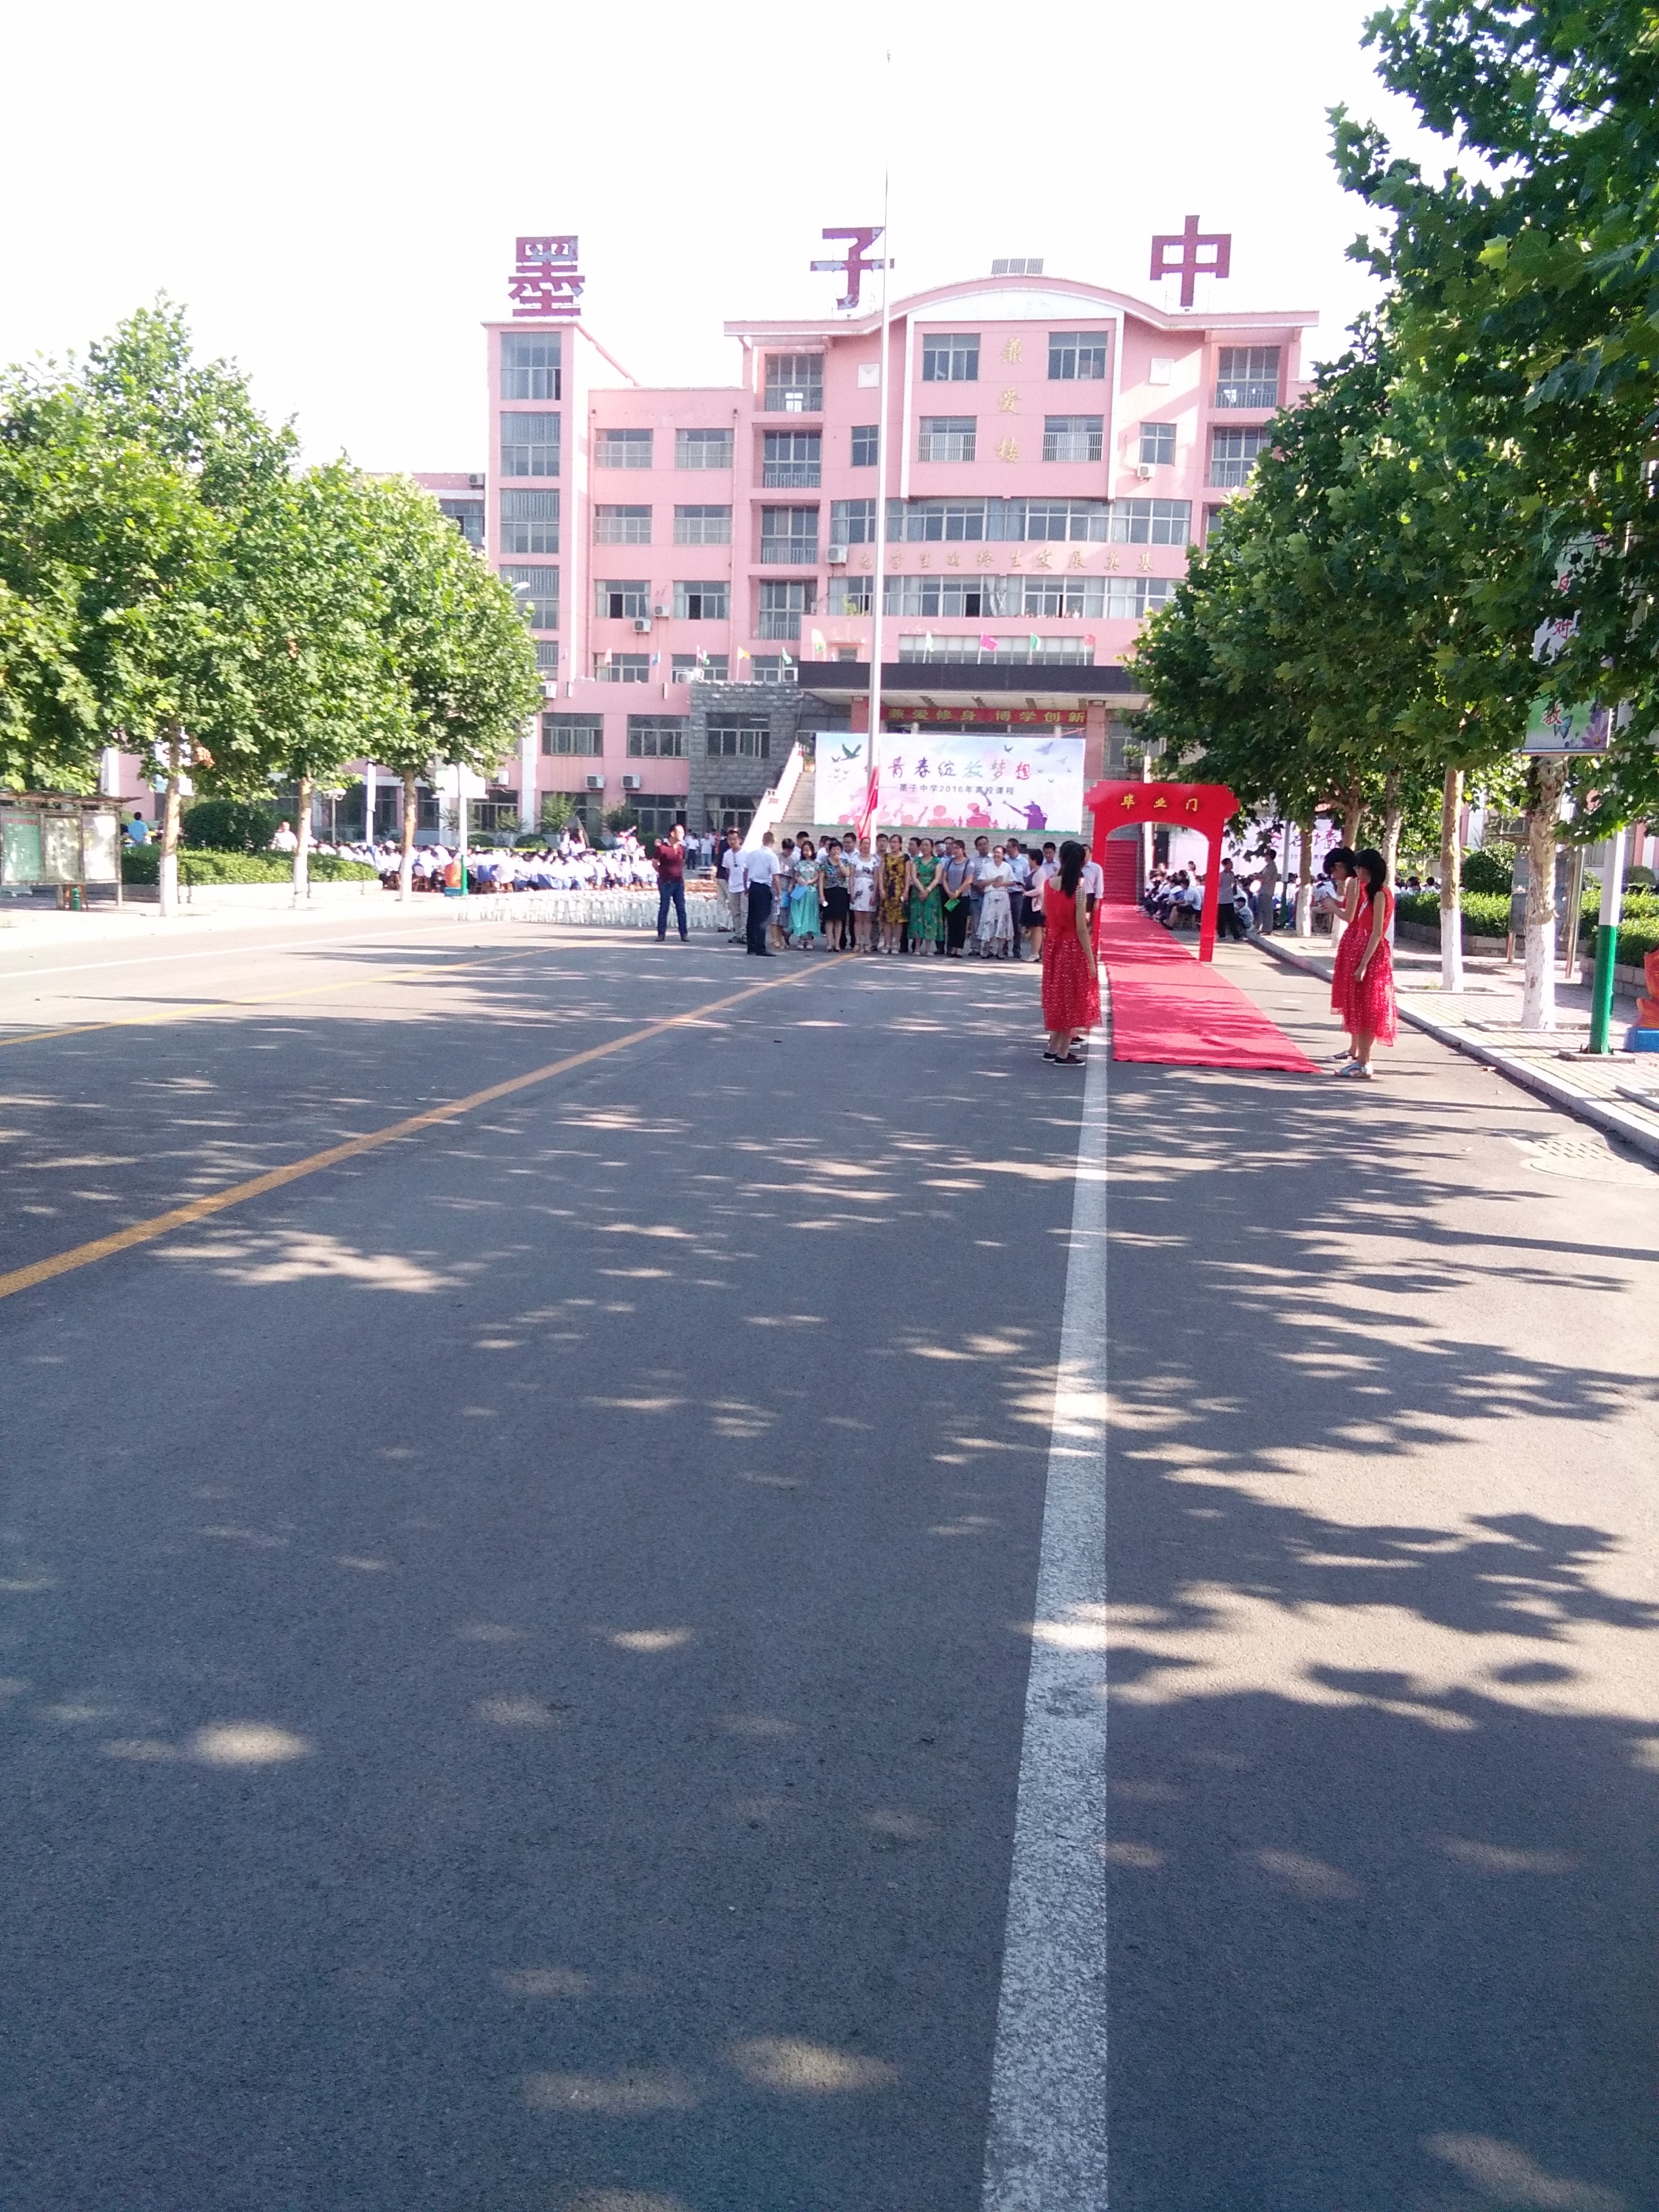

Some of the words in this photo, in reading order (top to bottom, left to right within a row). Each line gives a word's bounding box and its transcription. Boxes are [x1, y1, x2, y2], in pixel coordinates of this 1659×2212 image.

[994, 337, 1023, 464] 兼爱楼
[994, 710, 1085, 723] 博学创新
[863, 756, 1031, 781] 青春绽放梦想
[1120, 793, 1198, 812] 毕业门
